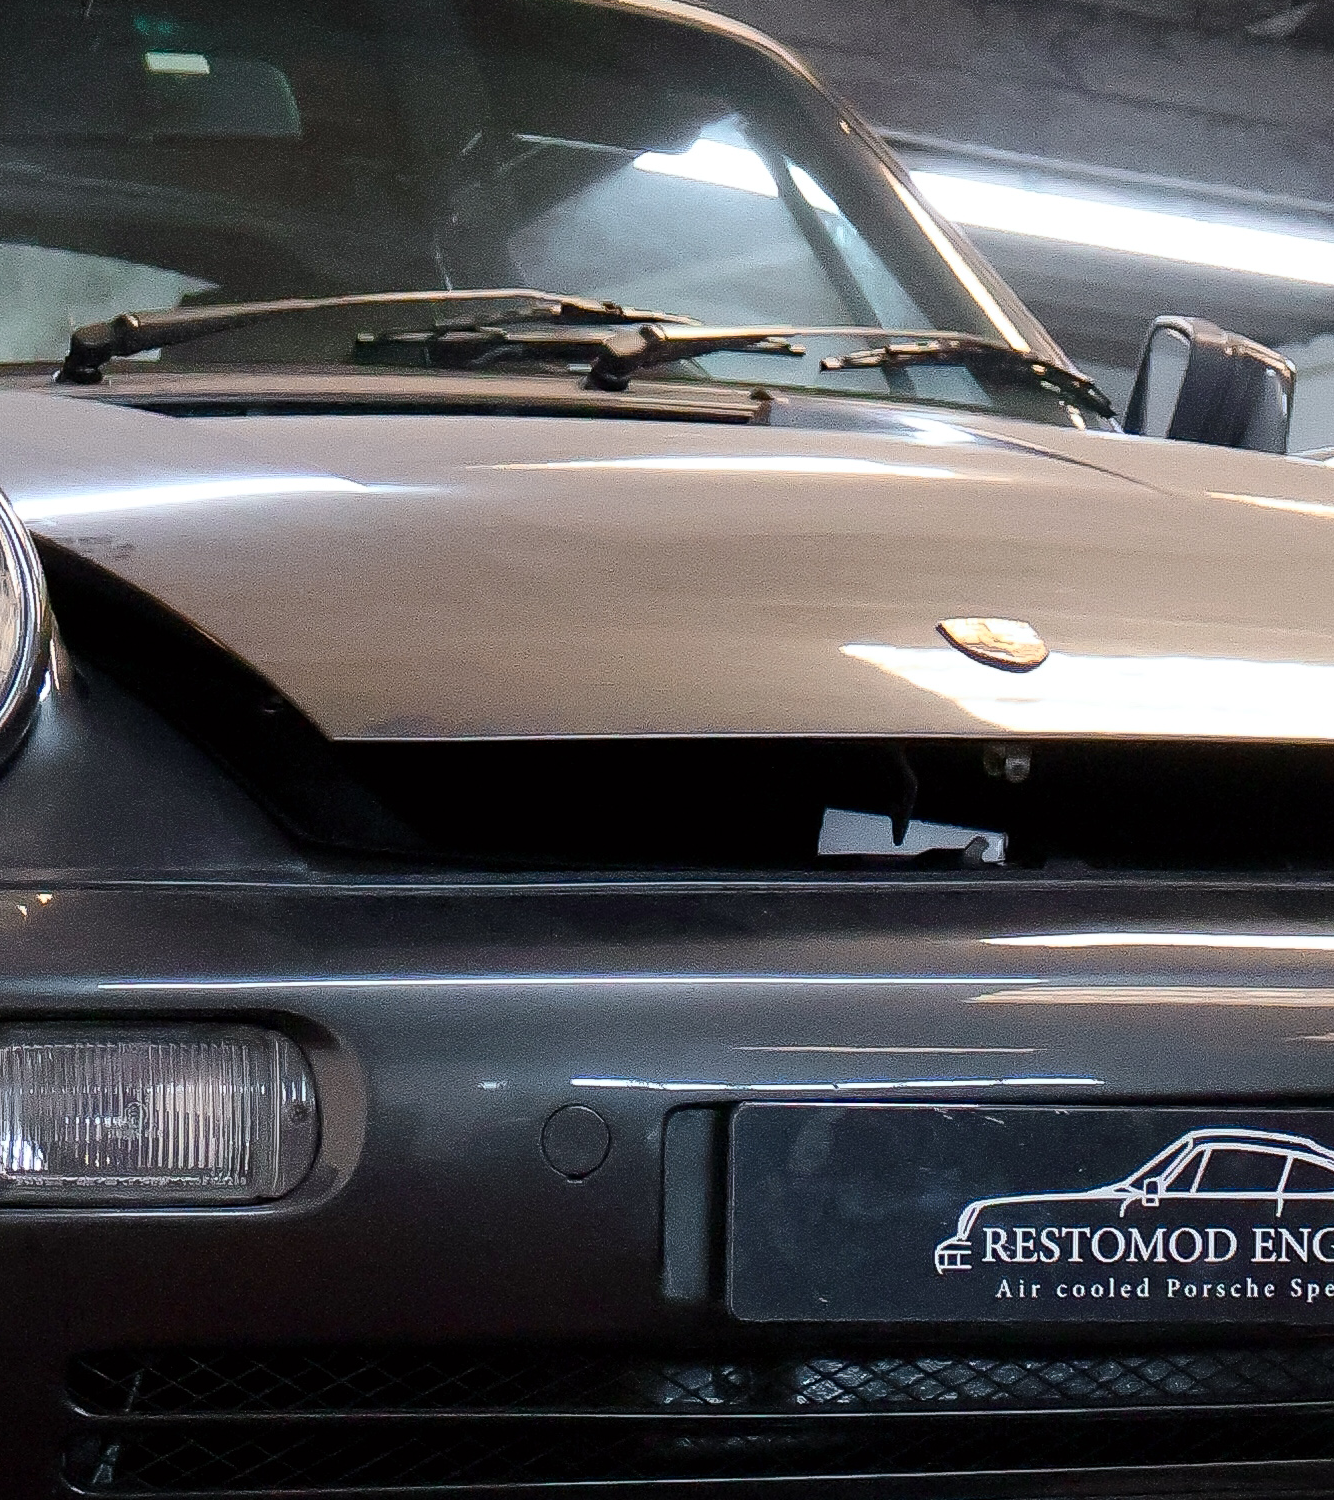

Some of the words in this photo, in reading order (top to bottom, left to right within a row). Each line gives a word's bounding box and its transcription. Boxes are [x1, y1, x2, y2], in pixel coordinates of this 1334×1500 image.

[981, 1226, 1238, 1263] RESTOMOD
[994, 1277, 1041, 1299] Air
[1056, 1277, 1150, 1299] cooled
[1166, 1277, 1275, 1299] Porsche
